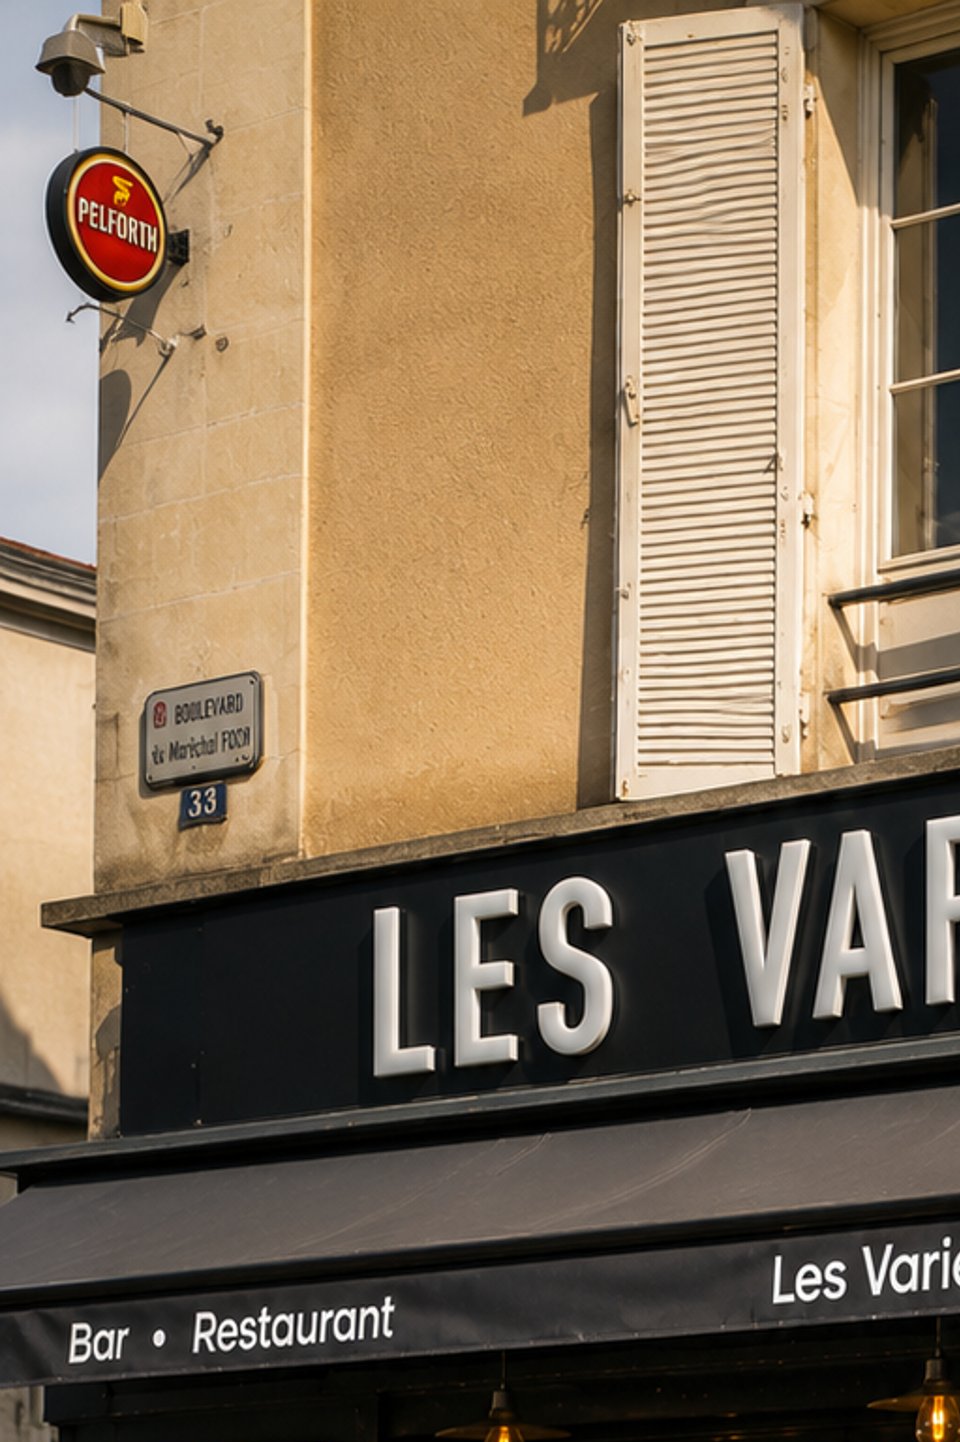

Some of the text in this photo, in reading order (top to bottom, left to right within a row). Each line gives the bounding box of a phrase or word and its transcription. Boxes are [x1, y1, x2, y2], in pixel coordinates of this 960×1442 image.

[77, 197, 158, 253] PELFORTH
[174, 693, 243, 725] BOULEVARD
[188, 787, 217, 817] 33
[373, 876, 613, 1078] LES
[772, 1255, 847, 1305] Les
[68, 1296, 395, 1364] Bar Restaurant
